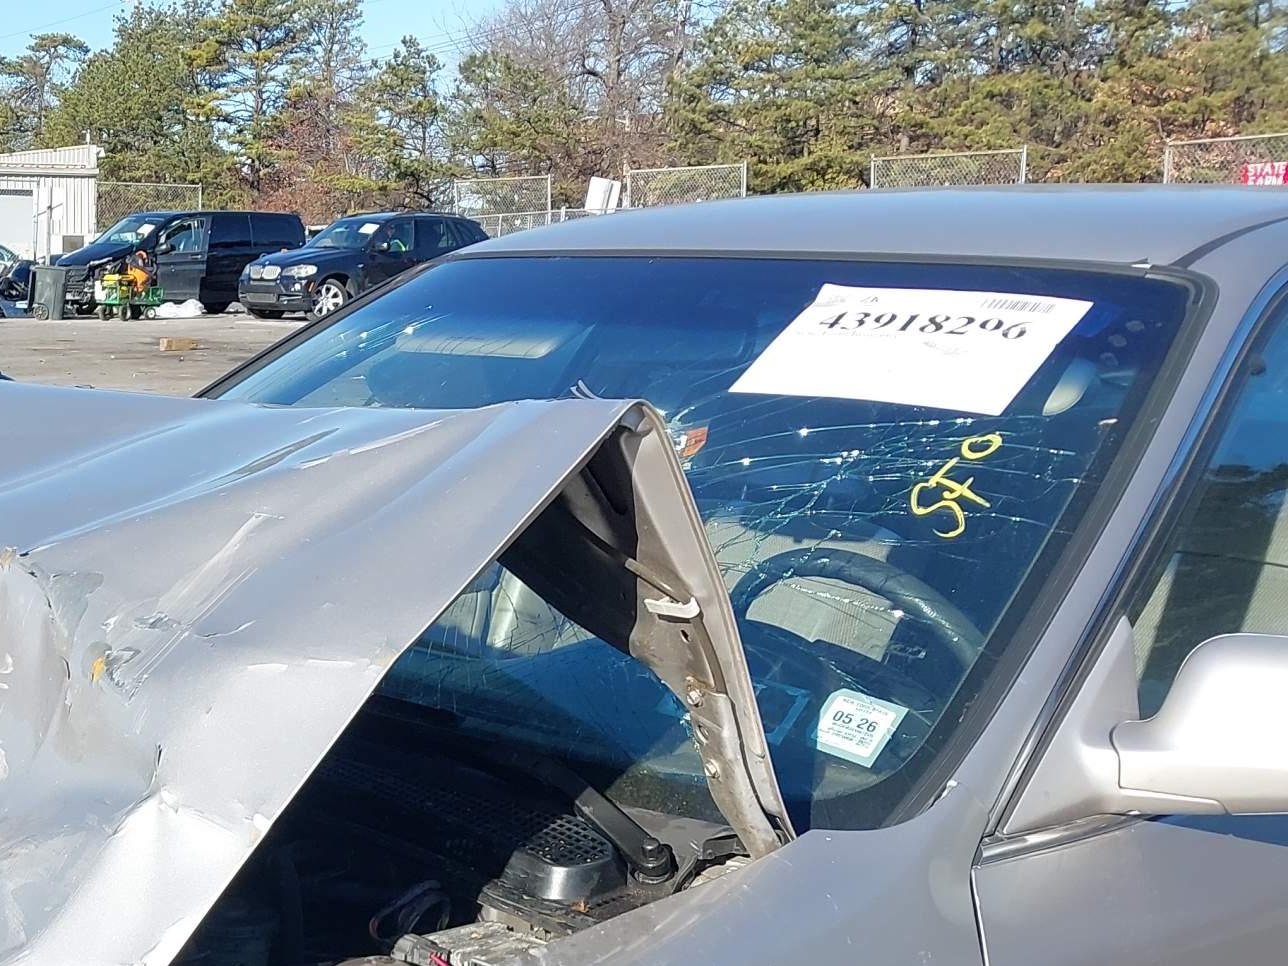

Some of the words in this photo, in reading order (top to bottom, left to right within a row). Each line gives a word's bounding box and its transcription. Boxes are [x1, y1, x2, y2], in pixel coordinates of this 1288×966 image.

[1247, 162, 1286, 176] STATE
[817, 311, 1033, 341] 43918296
[832, 710, 854, 725] 05
[856, 717, 879, 733] 26
